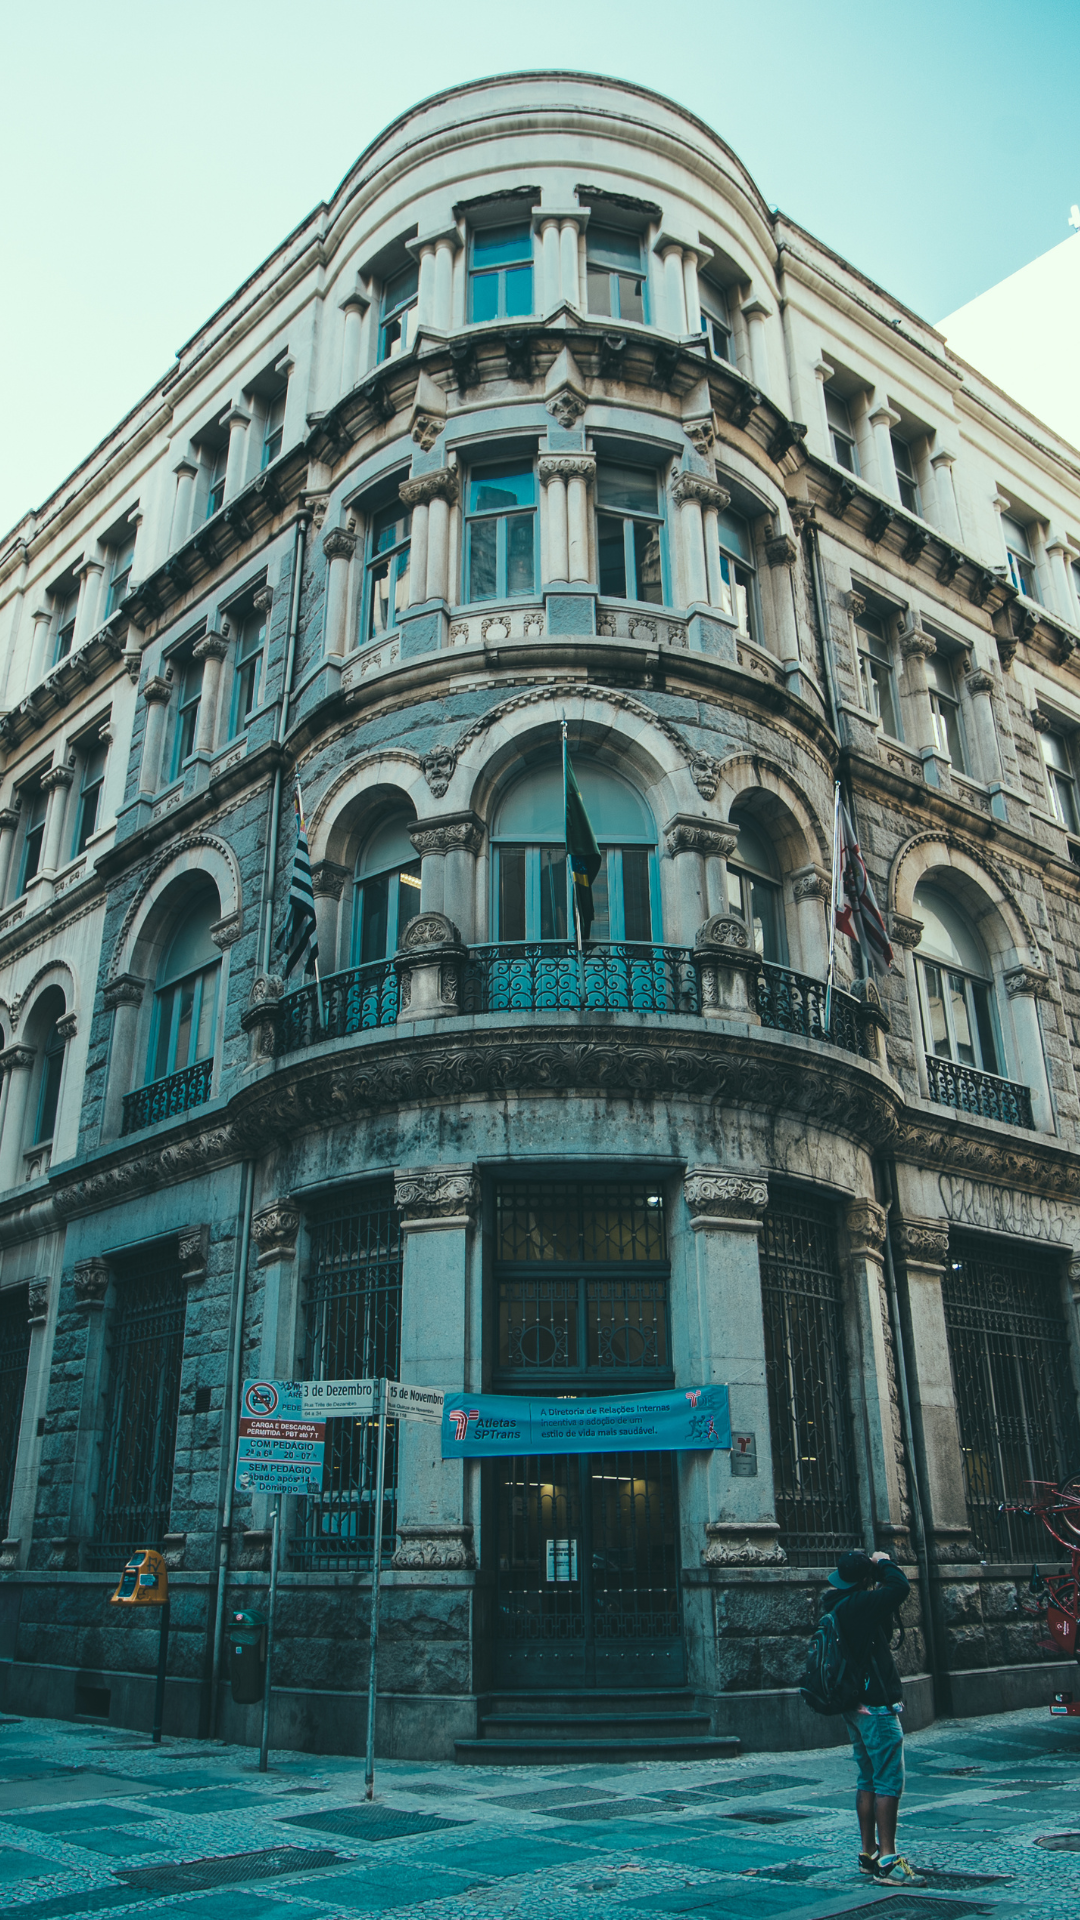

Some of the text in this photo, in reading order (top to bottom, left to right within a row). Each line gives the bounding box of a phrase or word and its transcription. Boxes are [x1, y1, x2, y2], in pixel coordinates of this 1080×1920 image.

[304, 1385, 309, 1397] 3
[312, 1385, 323, 1396] de
[326, 1383, 372, 1396] Dezembro
[390, 1386, 444, 1405] 15 de Novembro
[600, 1405, 634, 1414] Relações
[476, 1419, 516, 1428] Atletas
[541, 1419, 576, 1427] incentiva
[586, 1418, 615, 1426] adoção
[474, 1430, 521, 1440] SPTrans
[541, 1430, 564, 1438] estilo
[619, 1426, 658, 1435] saudável.
[273, 1440, 314, 1450] PEDÁGIO
[270, 1464, 312, 1474] PEDÁGIO
[260, 1483, 298, 1493] Domingo
